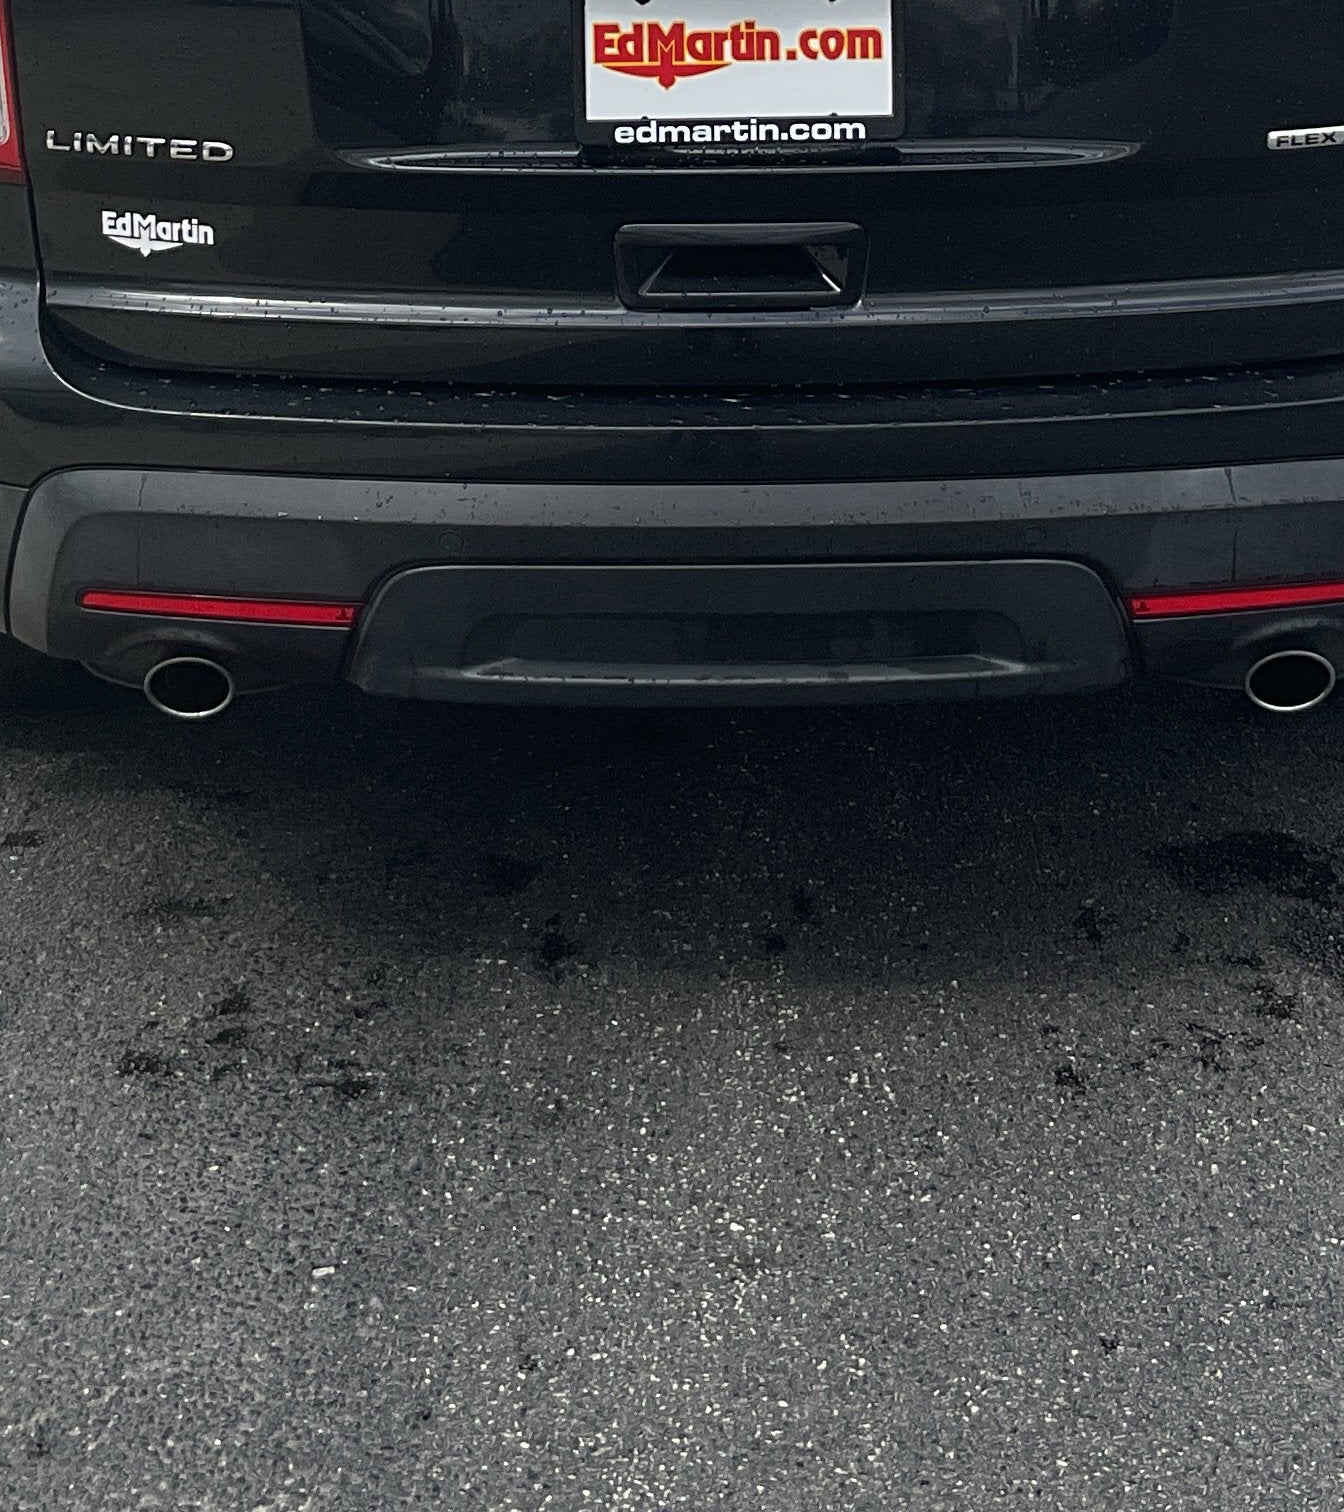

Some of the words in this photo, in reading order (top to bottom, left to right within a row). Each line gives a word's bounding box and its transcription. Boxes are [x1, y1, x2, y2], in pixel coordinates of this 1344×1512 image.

[591, 19, 884, 65] EdMartin.com
[46, 129, 235, 163] LIMITED
[613, 118, 867, 144] edmartin.com
[1275, 131, 1337, 148] FLEX
[101, 210, 216, 247] EdMartin
